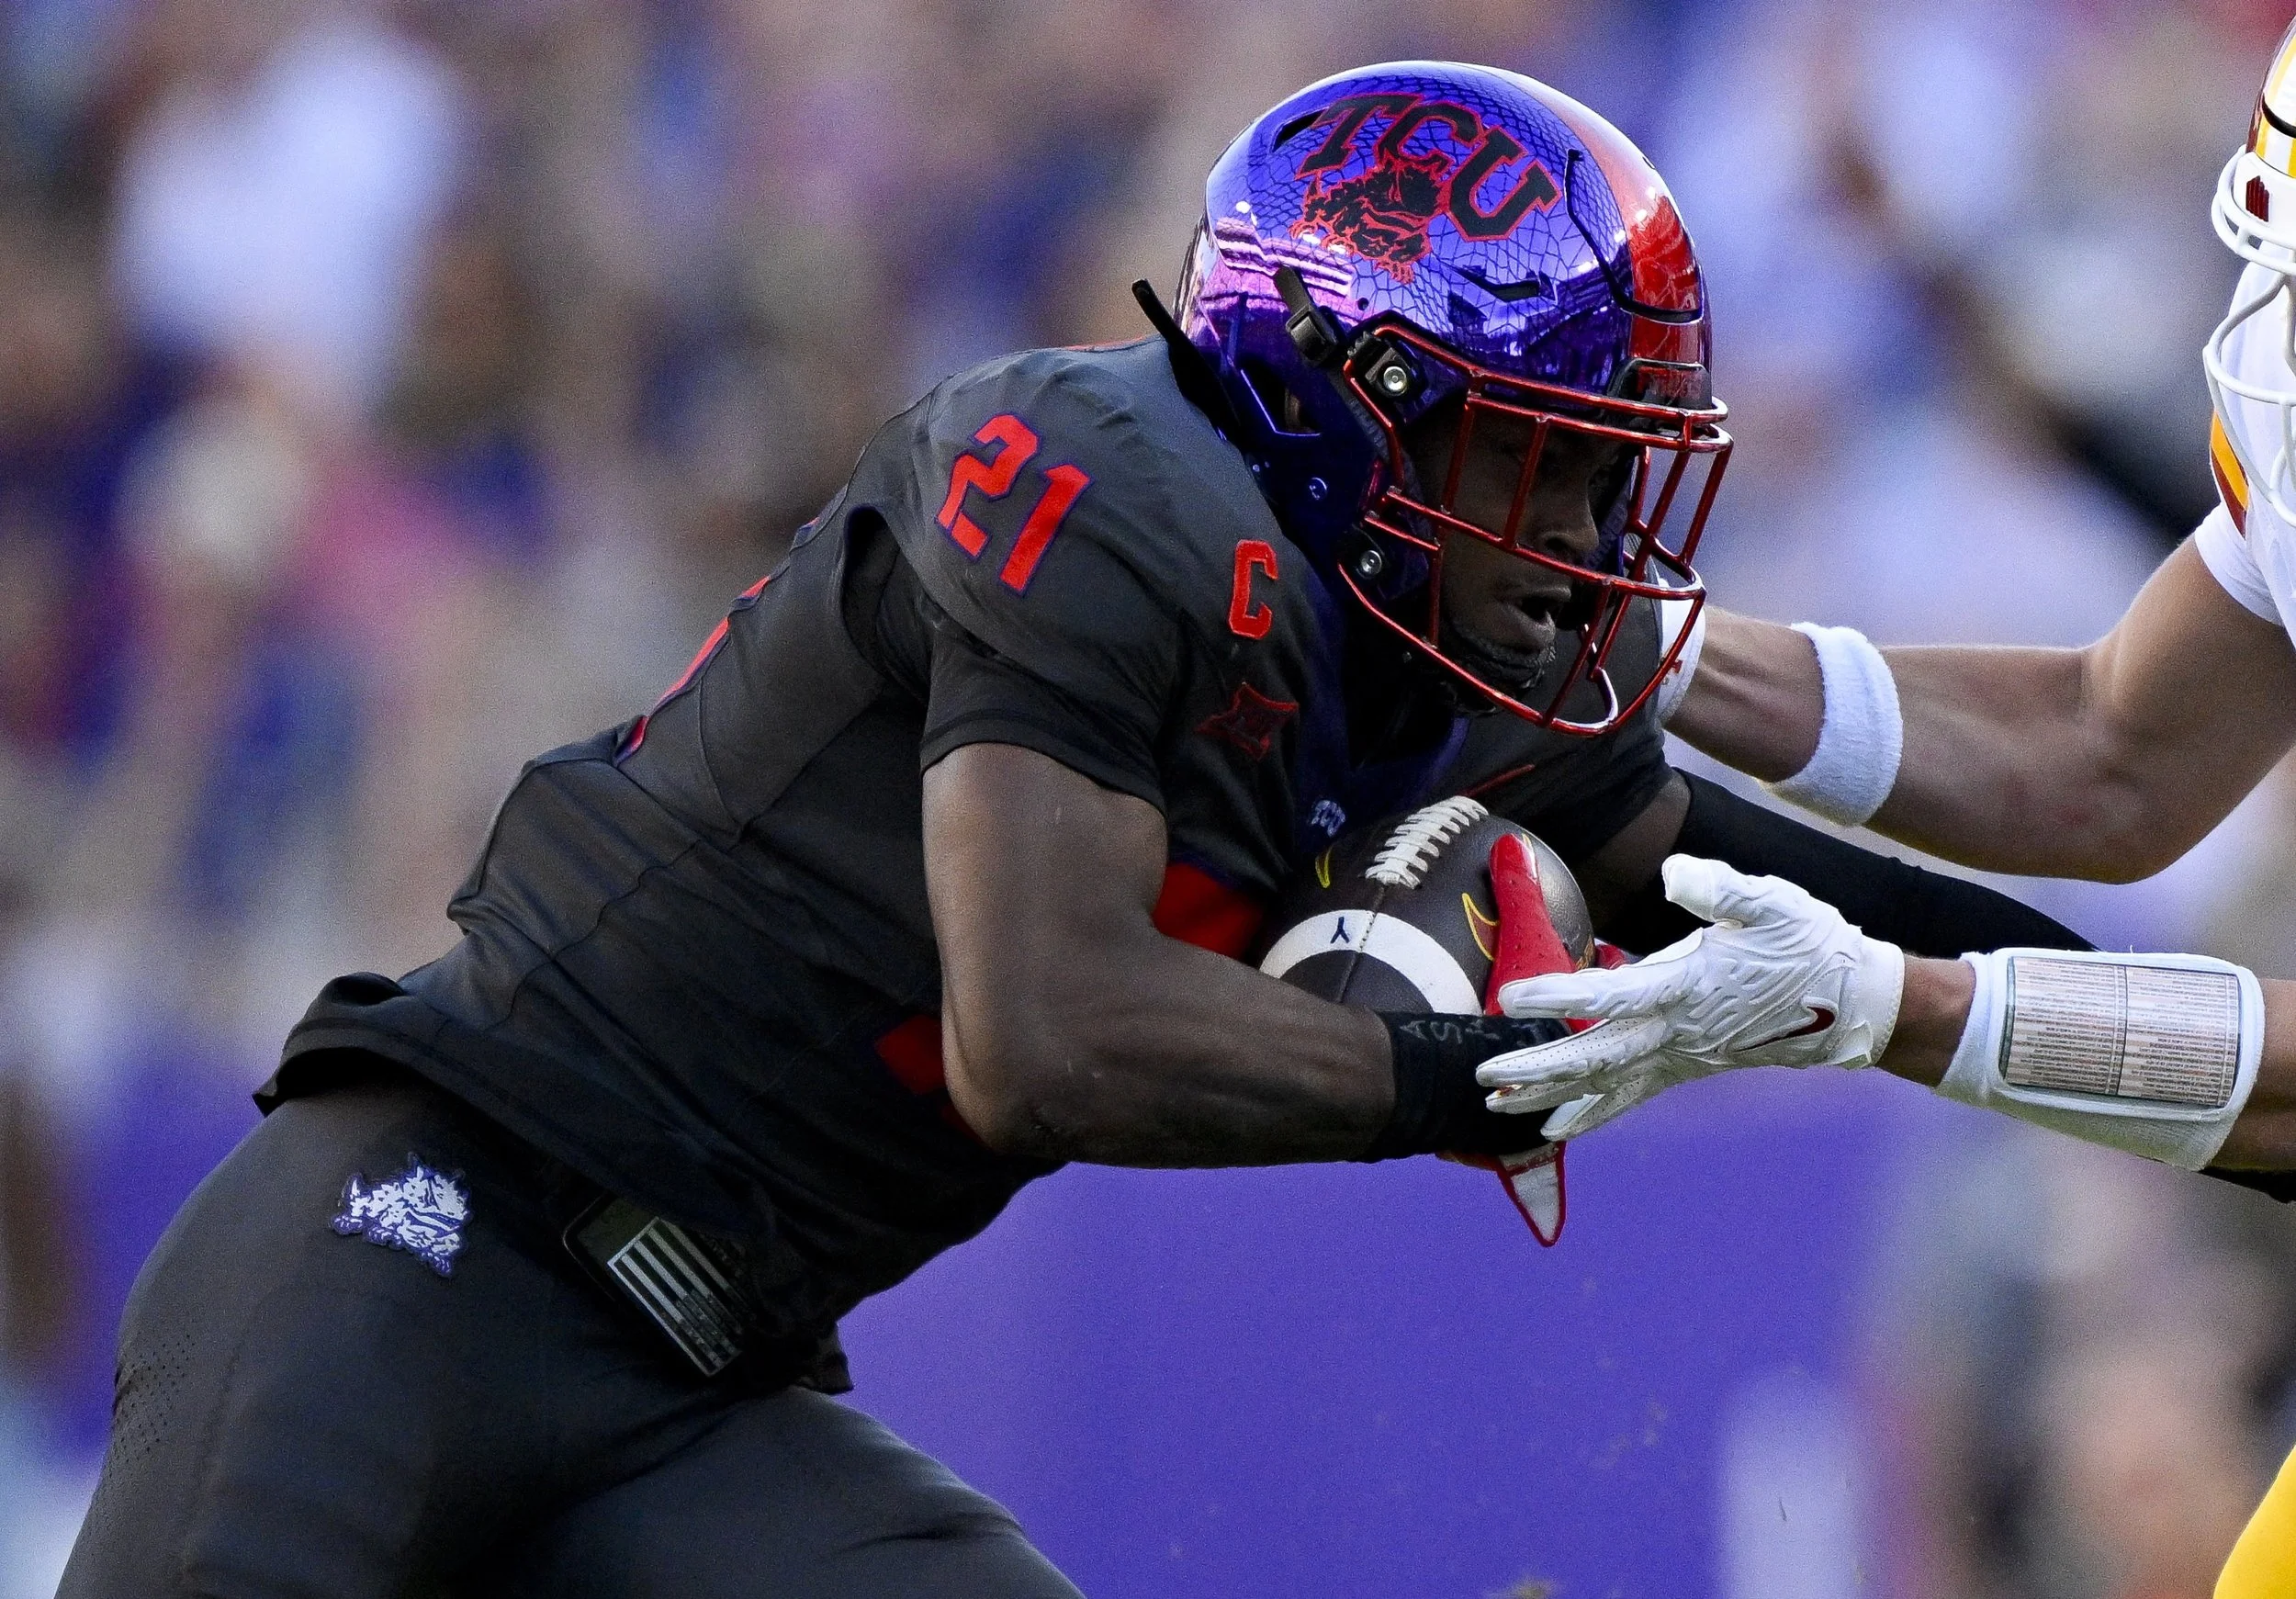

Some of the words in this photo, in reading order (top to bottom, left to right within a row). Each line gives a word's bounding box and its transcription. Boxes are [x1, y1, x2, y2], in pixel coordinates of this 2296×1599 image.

[1295, 92, 1562, 242] TCU
[936, 412, 1094, 595] 21
[1228, 539, 1277, 640] C
